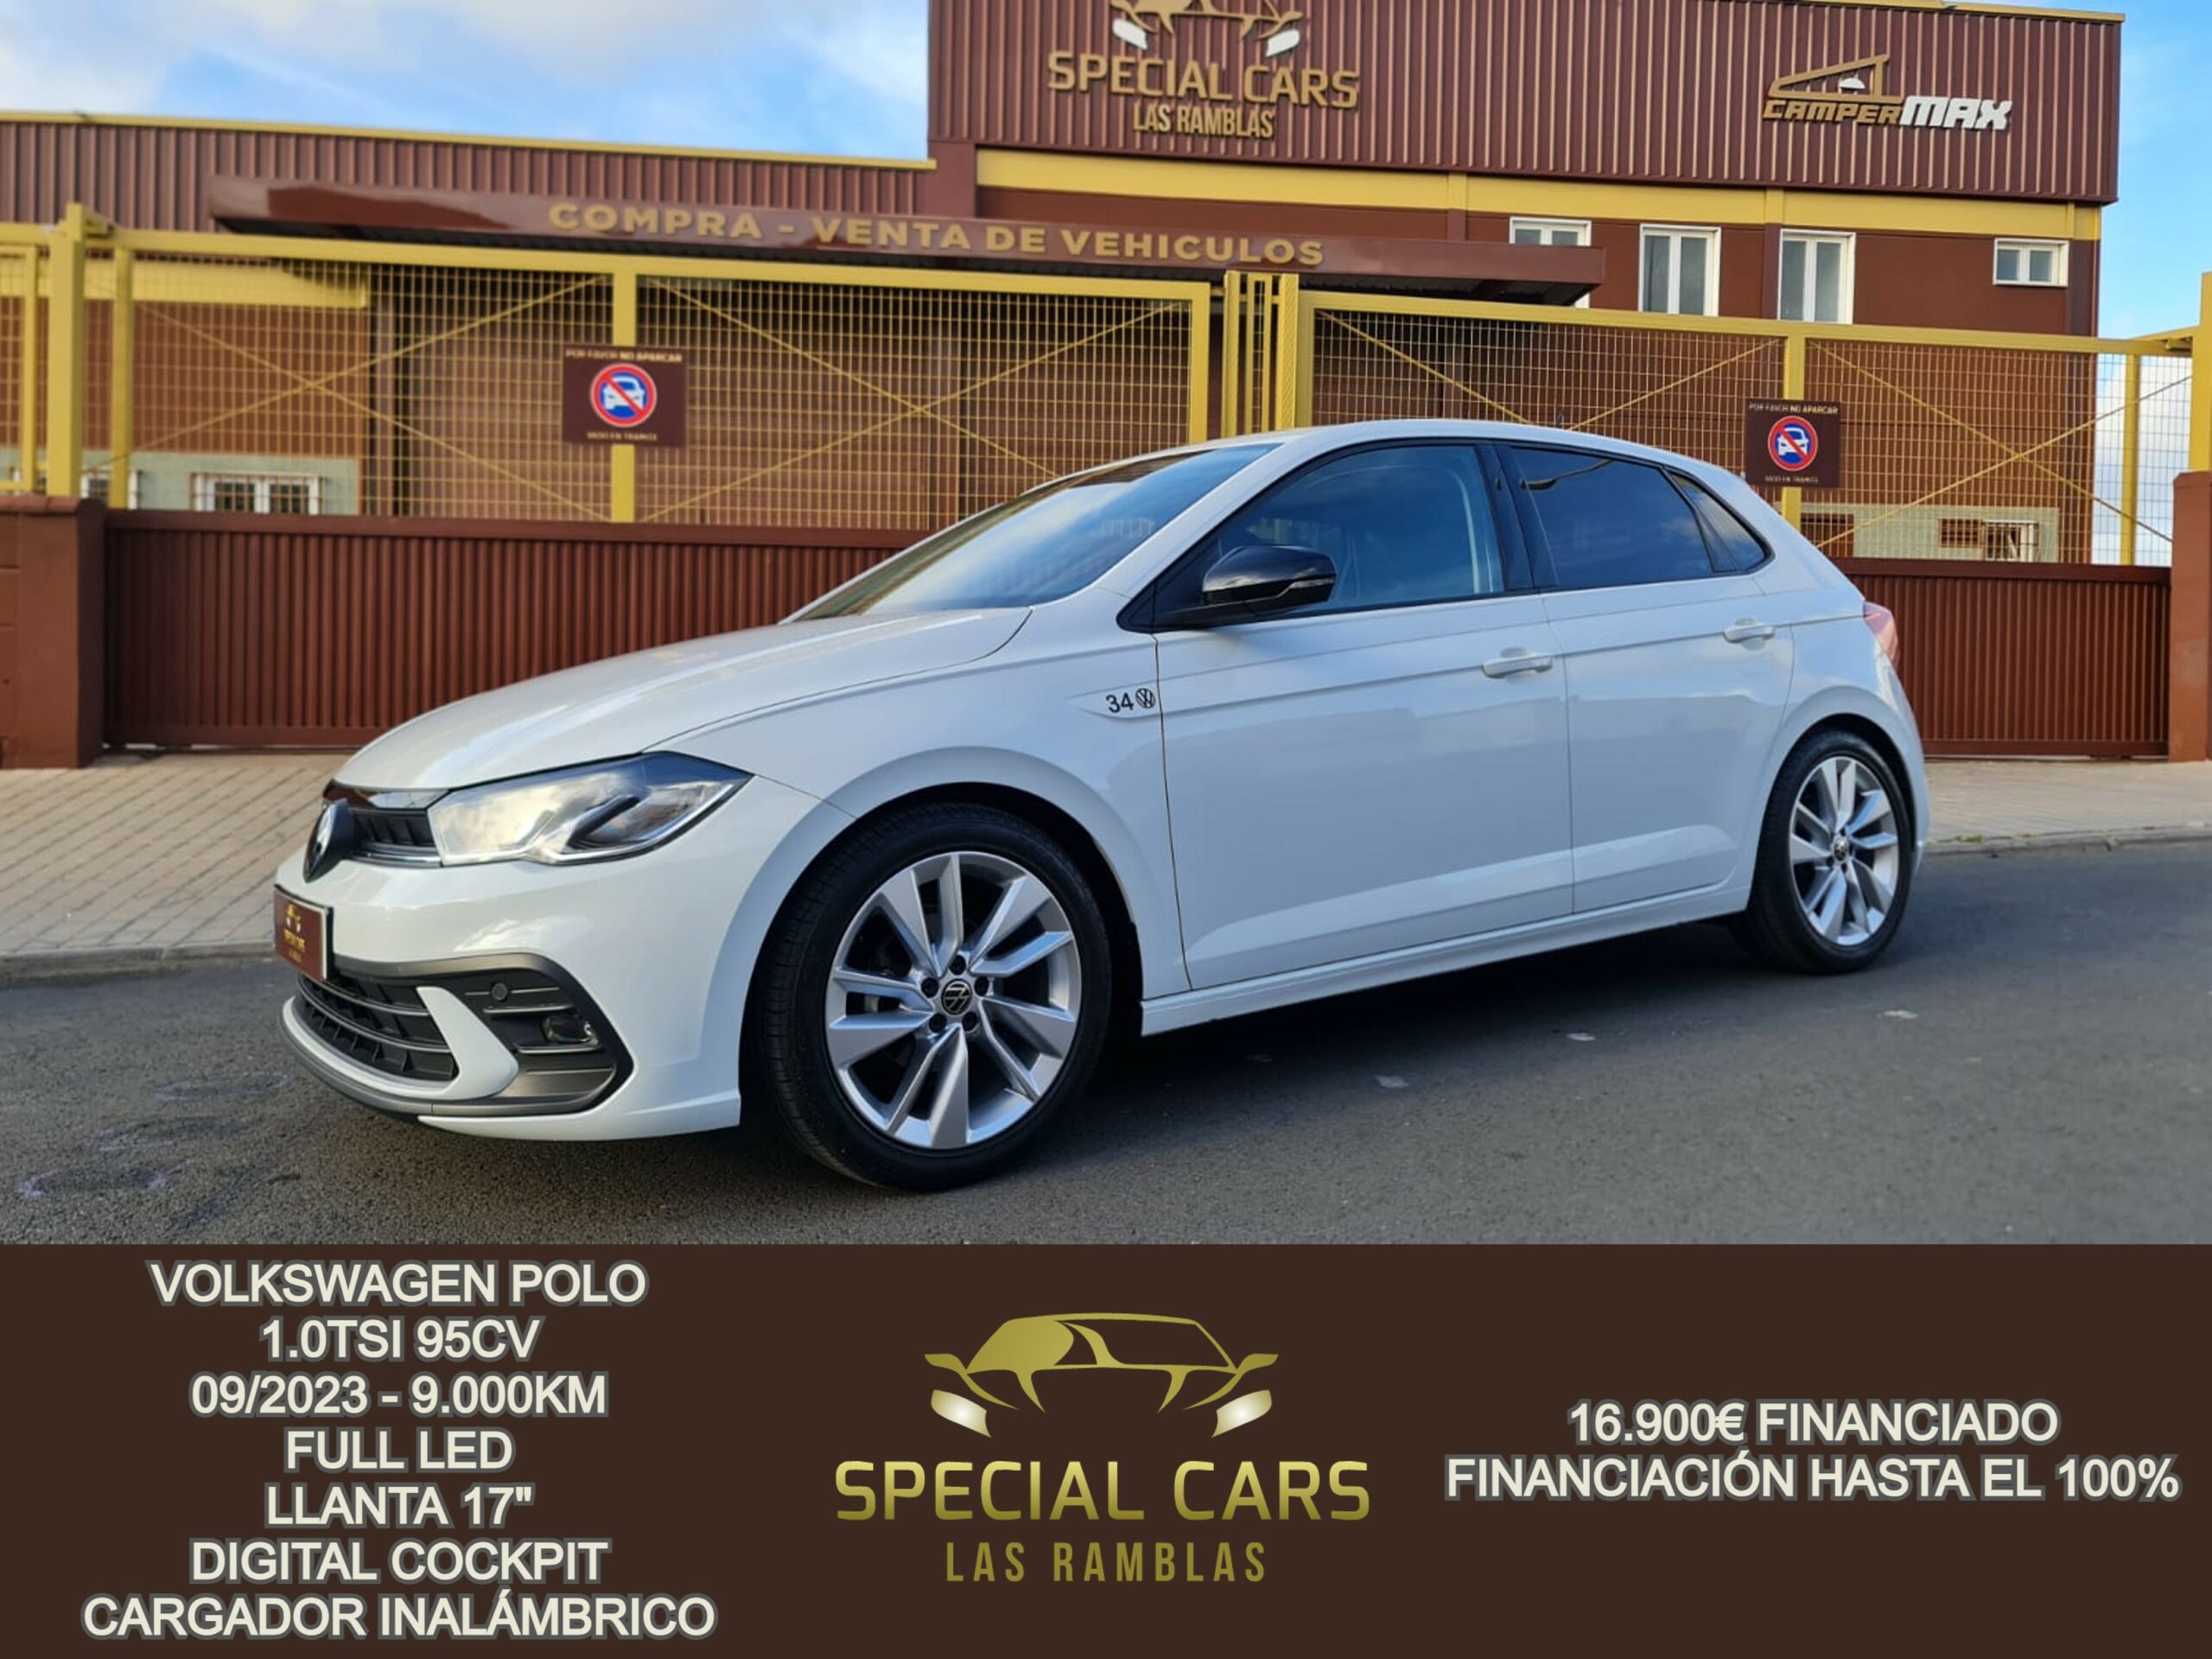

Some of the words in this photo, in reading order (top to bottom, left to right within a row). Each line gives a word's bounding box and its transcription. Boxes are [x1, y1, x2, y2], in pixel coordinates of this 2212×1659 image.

[1047, 51, 1233, 100] SPECIAL
[1243, 64, 1361, 109] CARS
[1133, 103, 1172, 132] LAS
[1176, 105, 1274, 139] RAMBLAS
[549, 201, 763, 239] COMPRA
[810, 216, 973, 251] VENTA
[986, 225, 1046, 254] DE
[1060, 228, 1324, 266] VEHICULOS
[1105, 691, 1134, 713] 34
